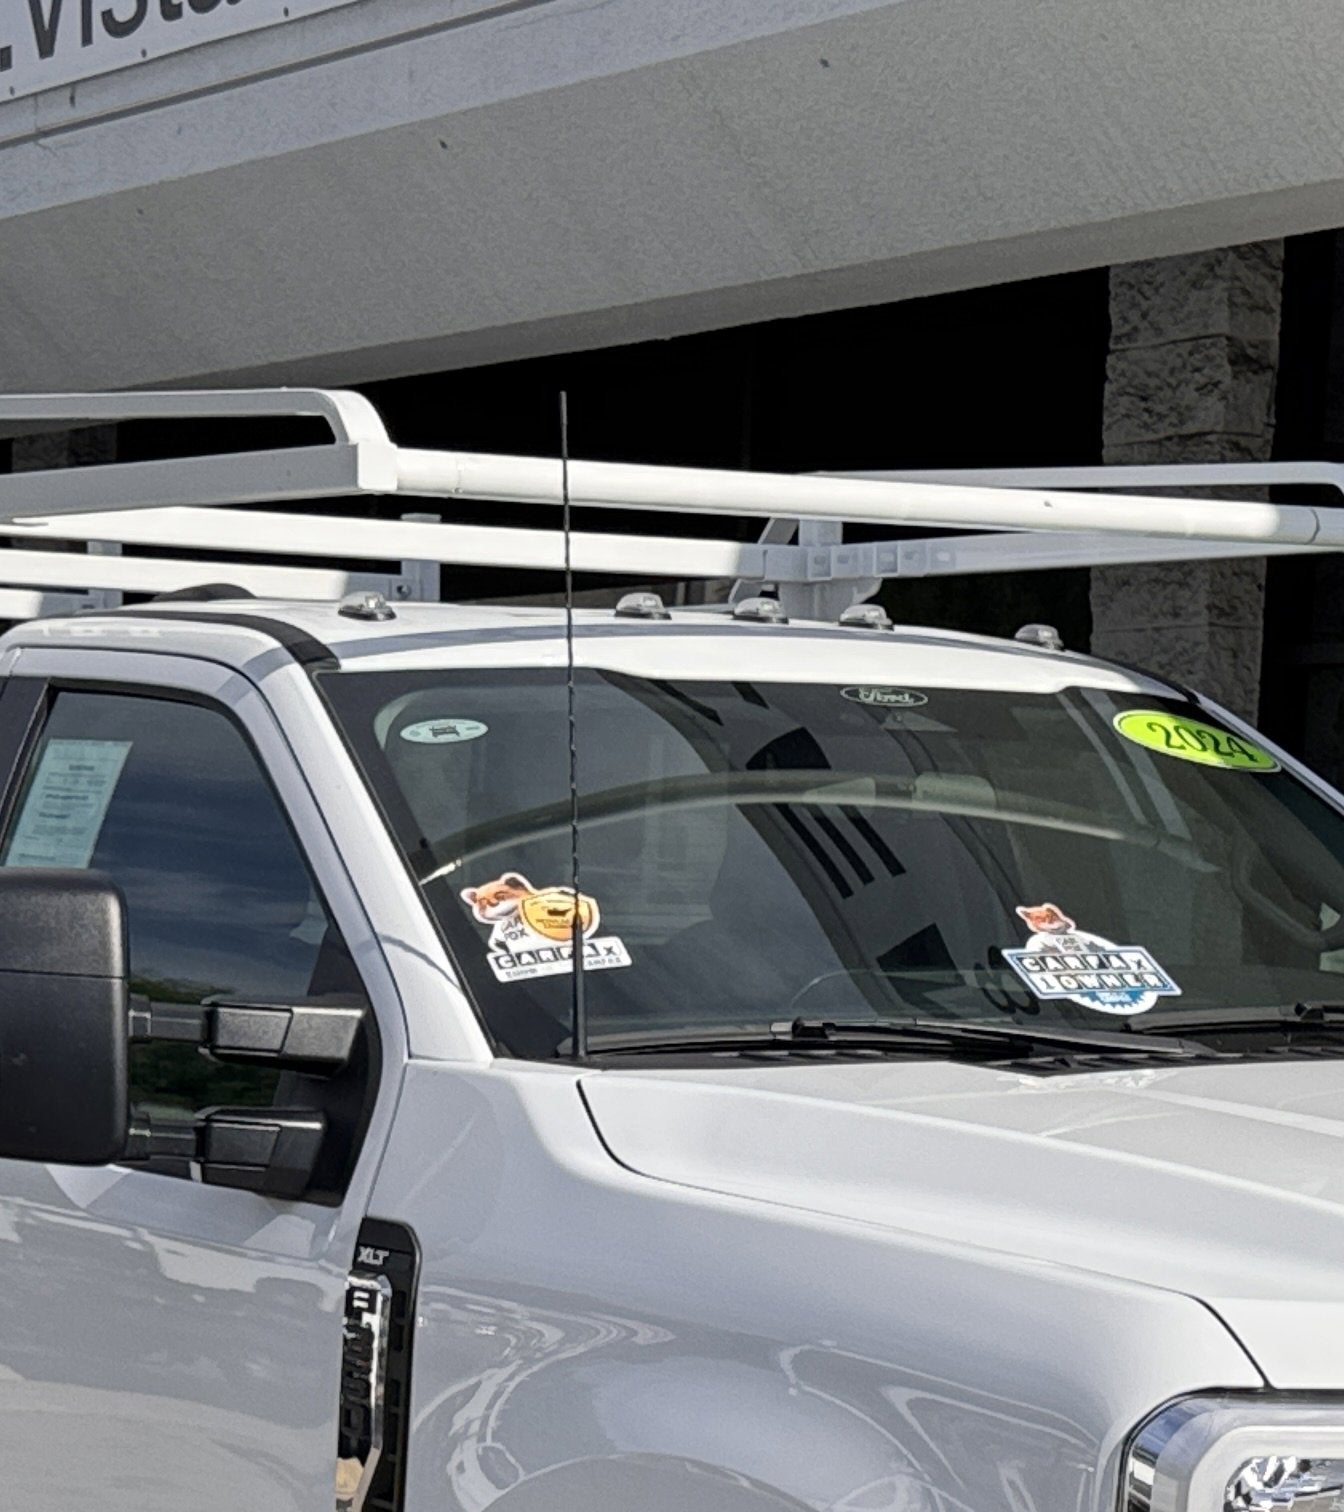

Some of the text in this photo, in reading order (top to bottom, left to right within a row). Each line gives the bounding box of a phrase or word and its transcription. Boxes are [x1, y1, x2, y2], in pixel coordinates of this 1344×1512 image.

[1146, 721, 1259, 763] 2024
[1020, 954, 1150, 973] CARFAX
[357, 1246, 389, 1265] XLT
